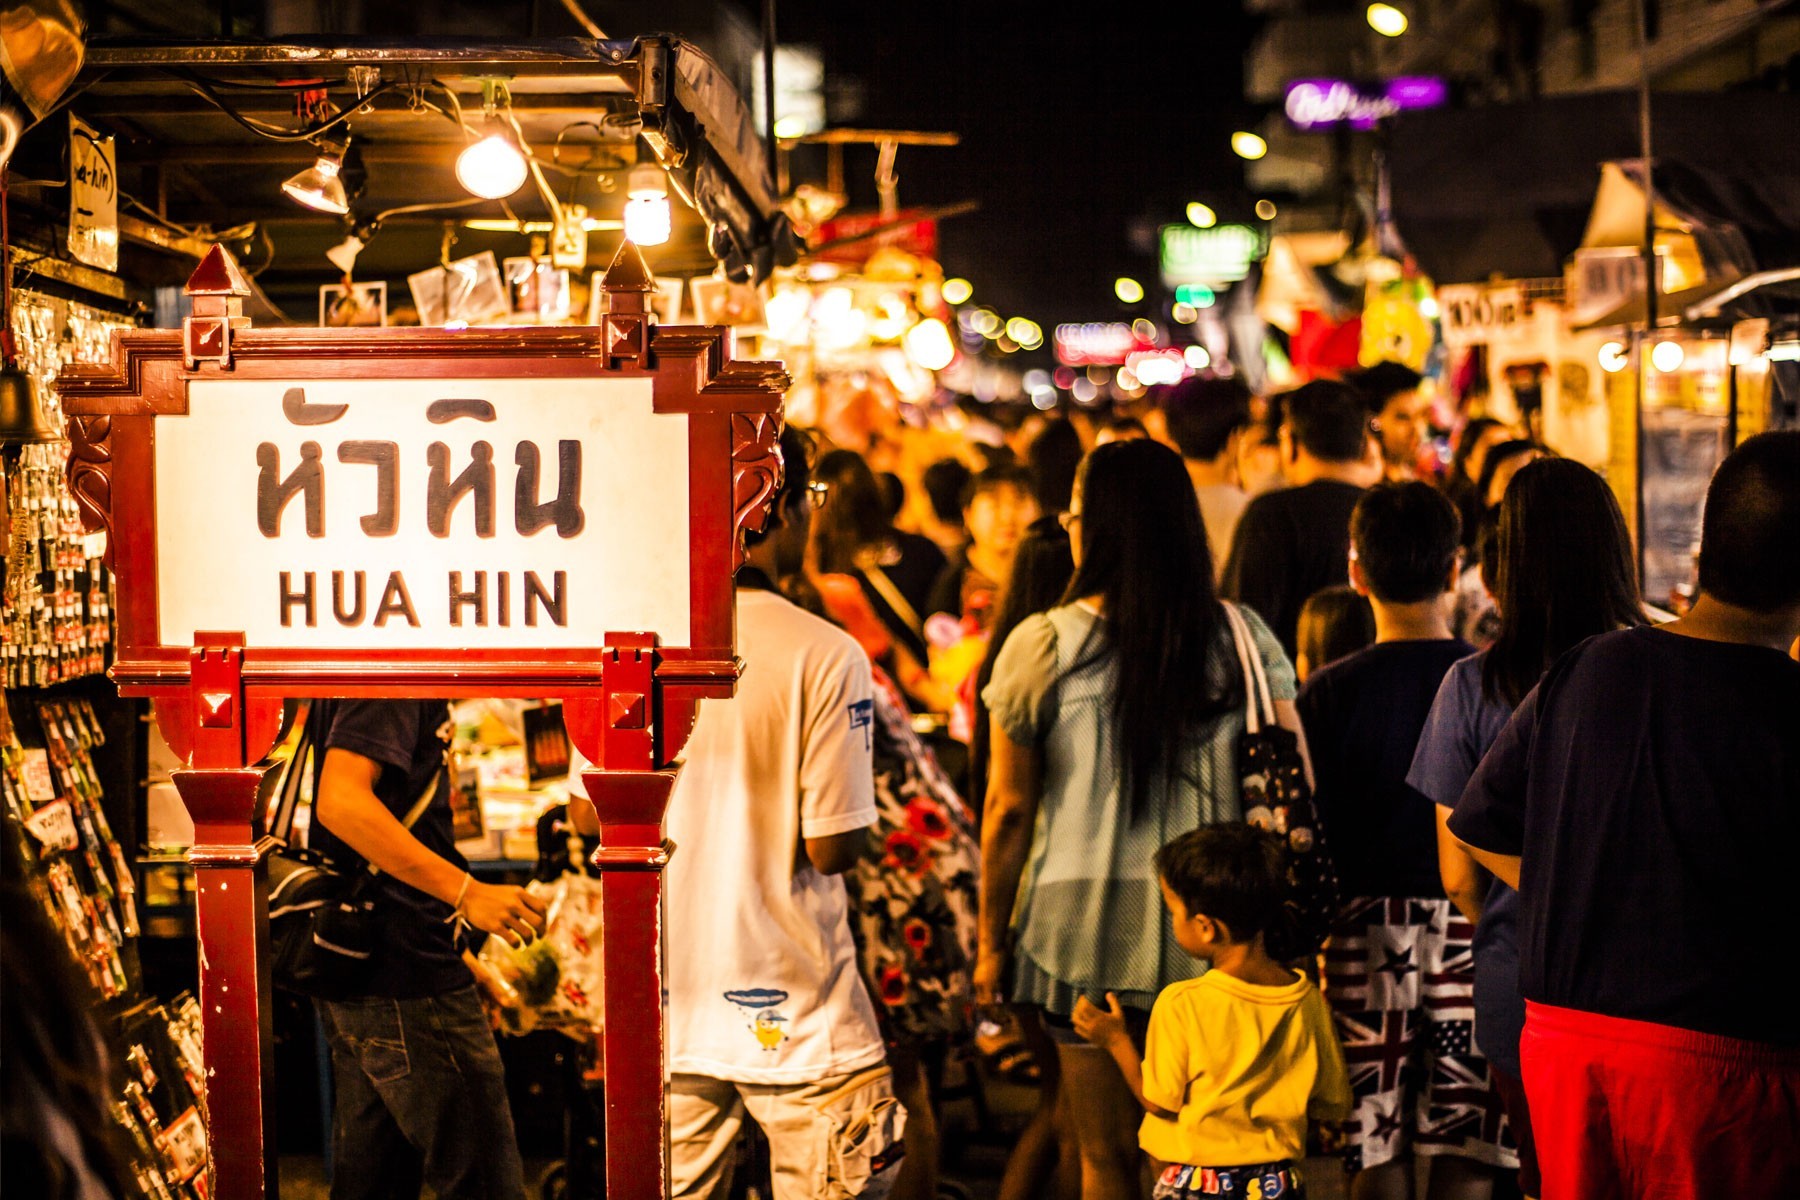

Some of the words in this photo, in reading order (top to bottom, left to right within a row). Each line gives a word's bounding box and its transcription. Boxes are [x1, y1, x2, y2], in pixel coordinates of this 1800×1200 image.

[256, 387, 585, 539] หัวหิน
[279, 570, 421, 628] HUA
[448, 570, 568, 628] HIN
